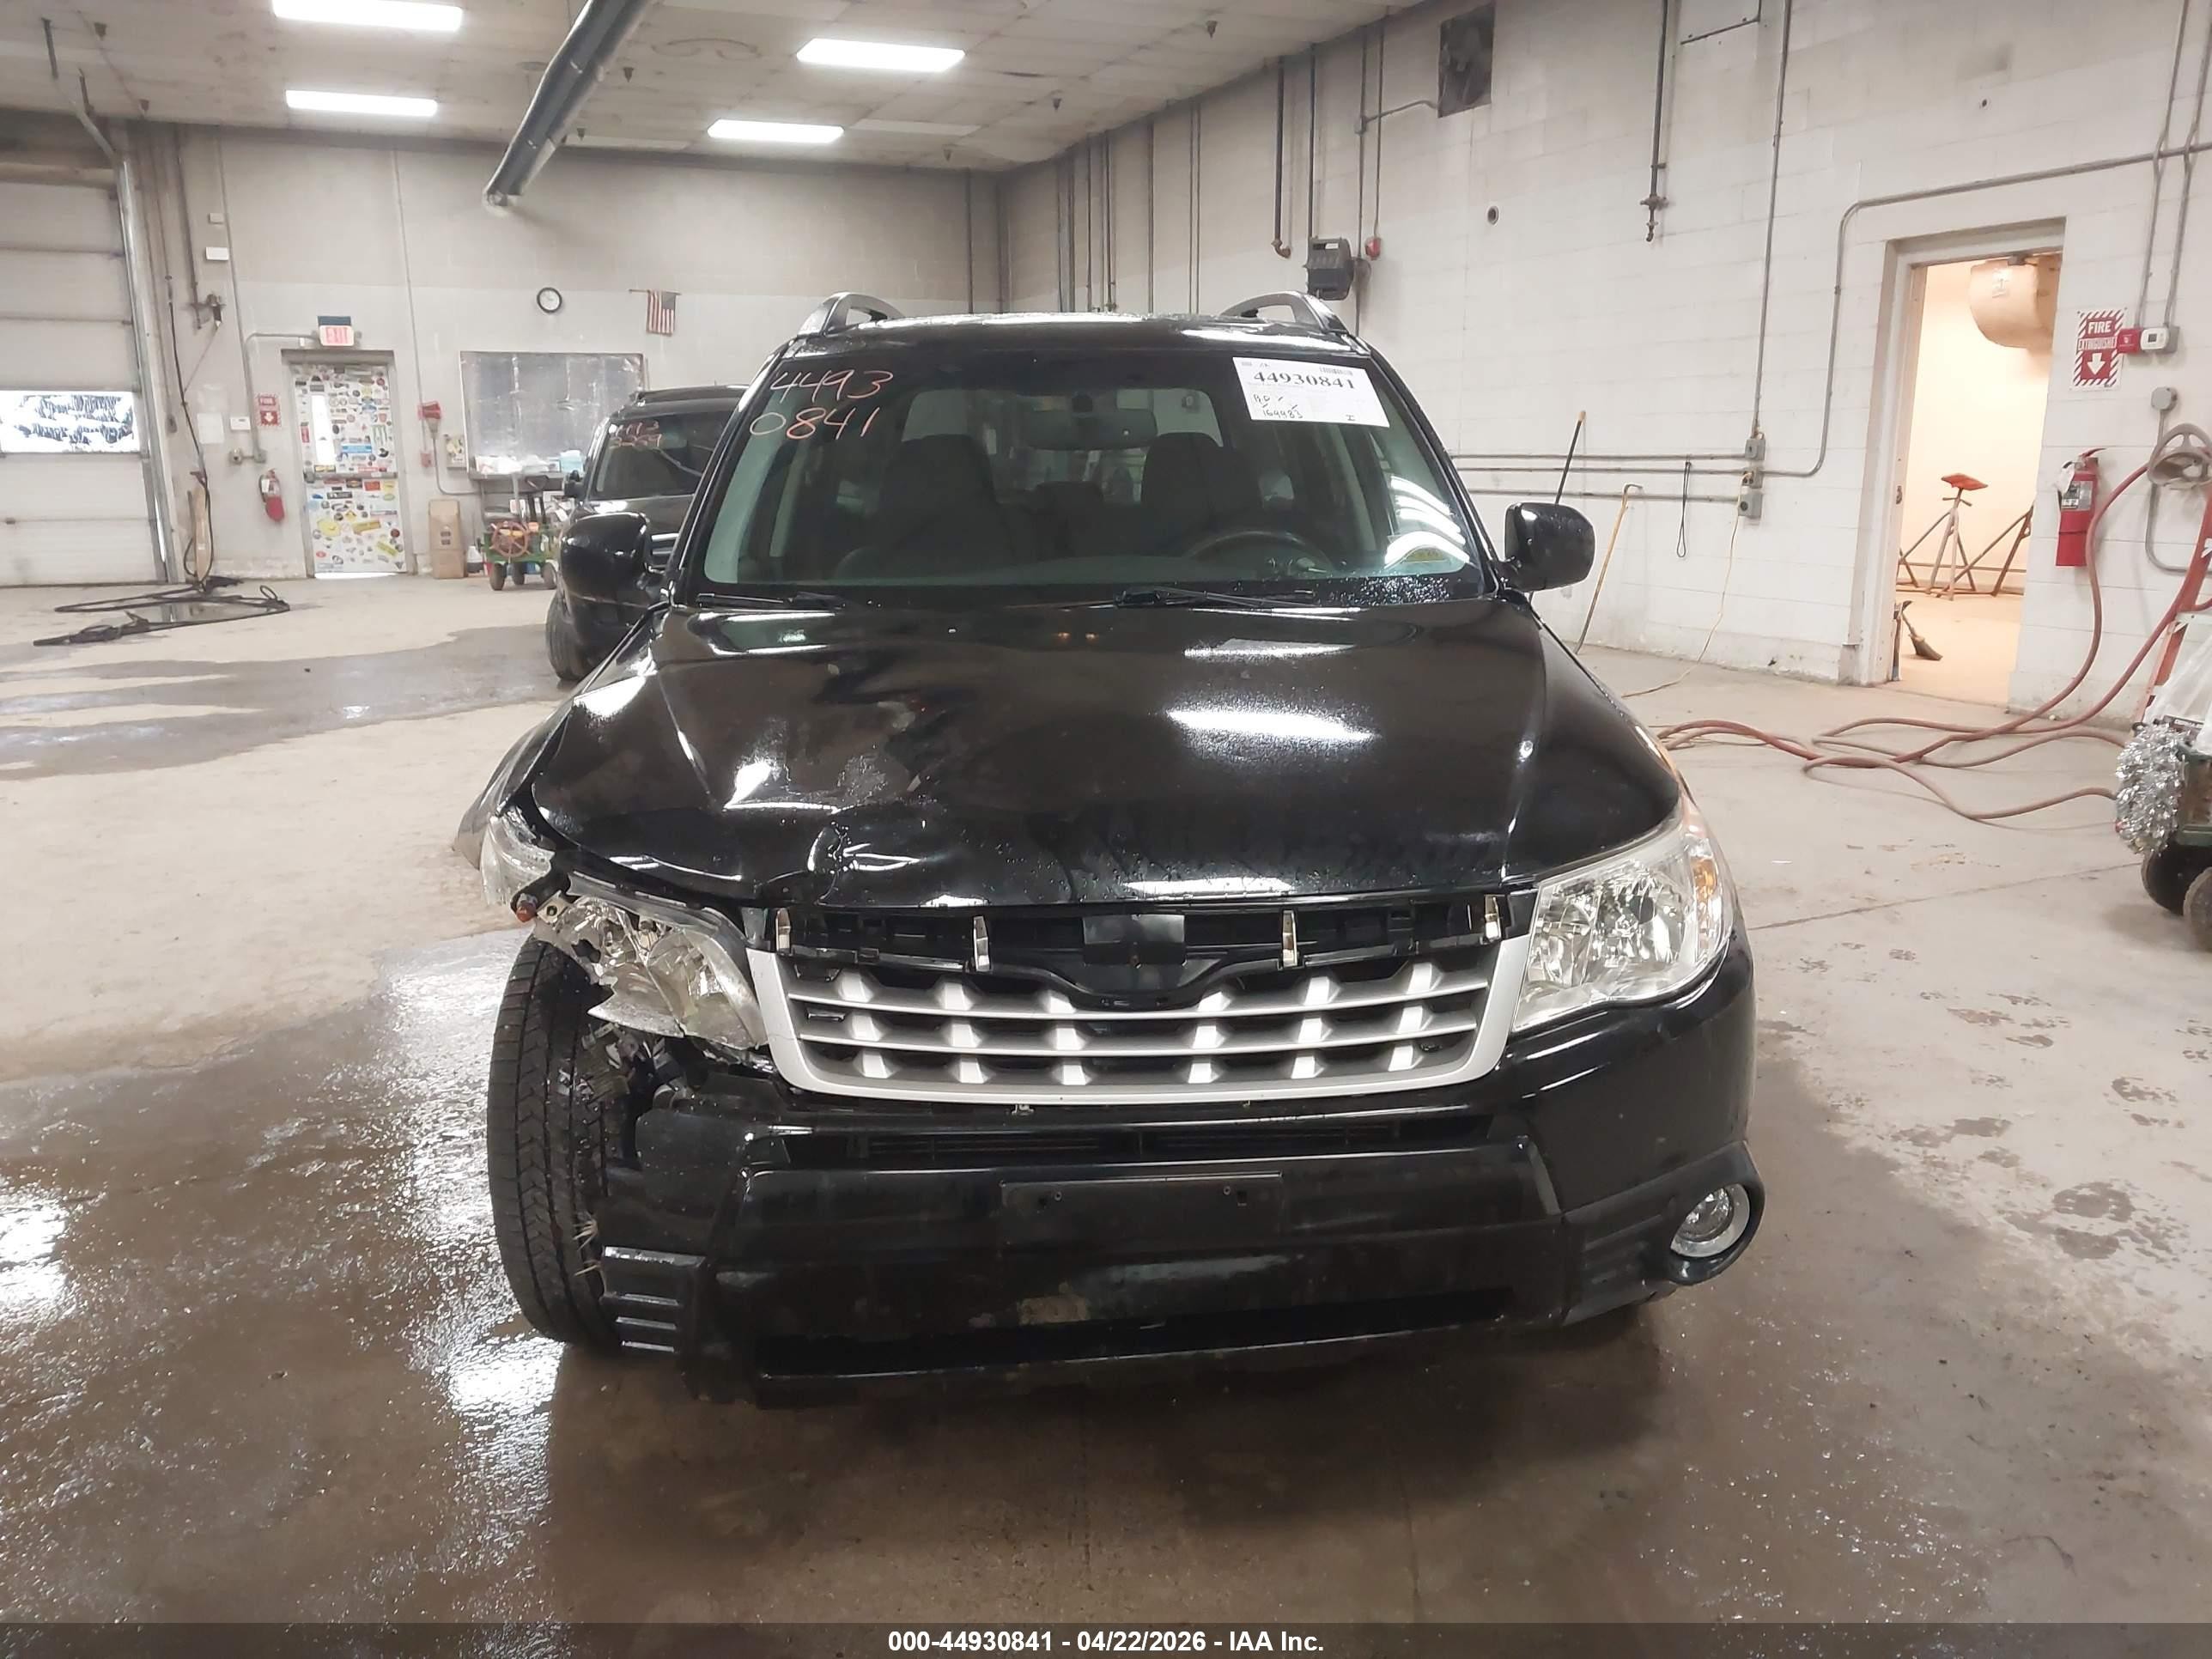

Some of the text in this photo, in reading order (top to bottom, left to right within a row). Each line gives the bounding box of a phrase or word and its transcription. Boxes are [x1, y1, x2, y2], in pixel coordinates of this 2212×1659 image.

[325, 326, 349, 344] EXIT
[2087, 320, 2112, 333] FIRE
[770, 369, 894, 404] 4493
[1254, 371, 1355, 389] 44930841
[749, 407, 880, 441] 0841
